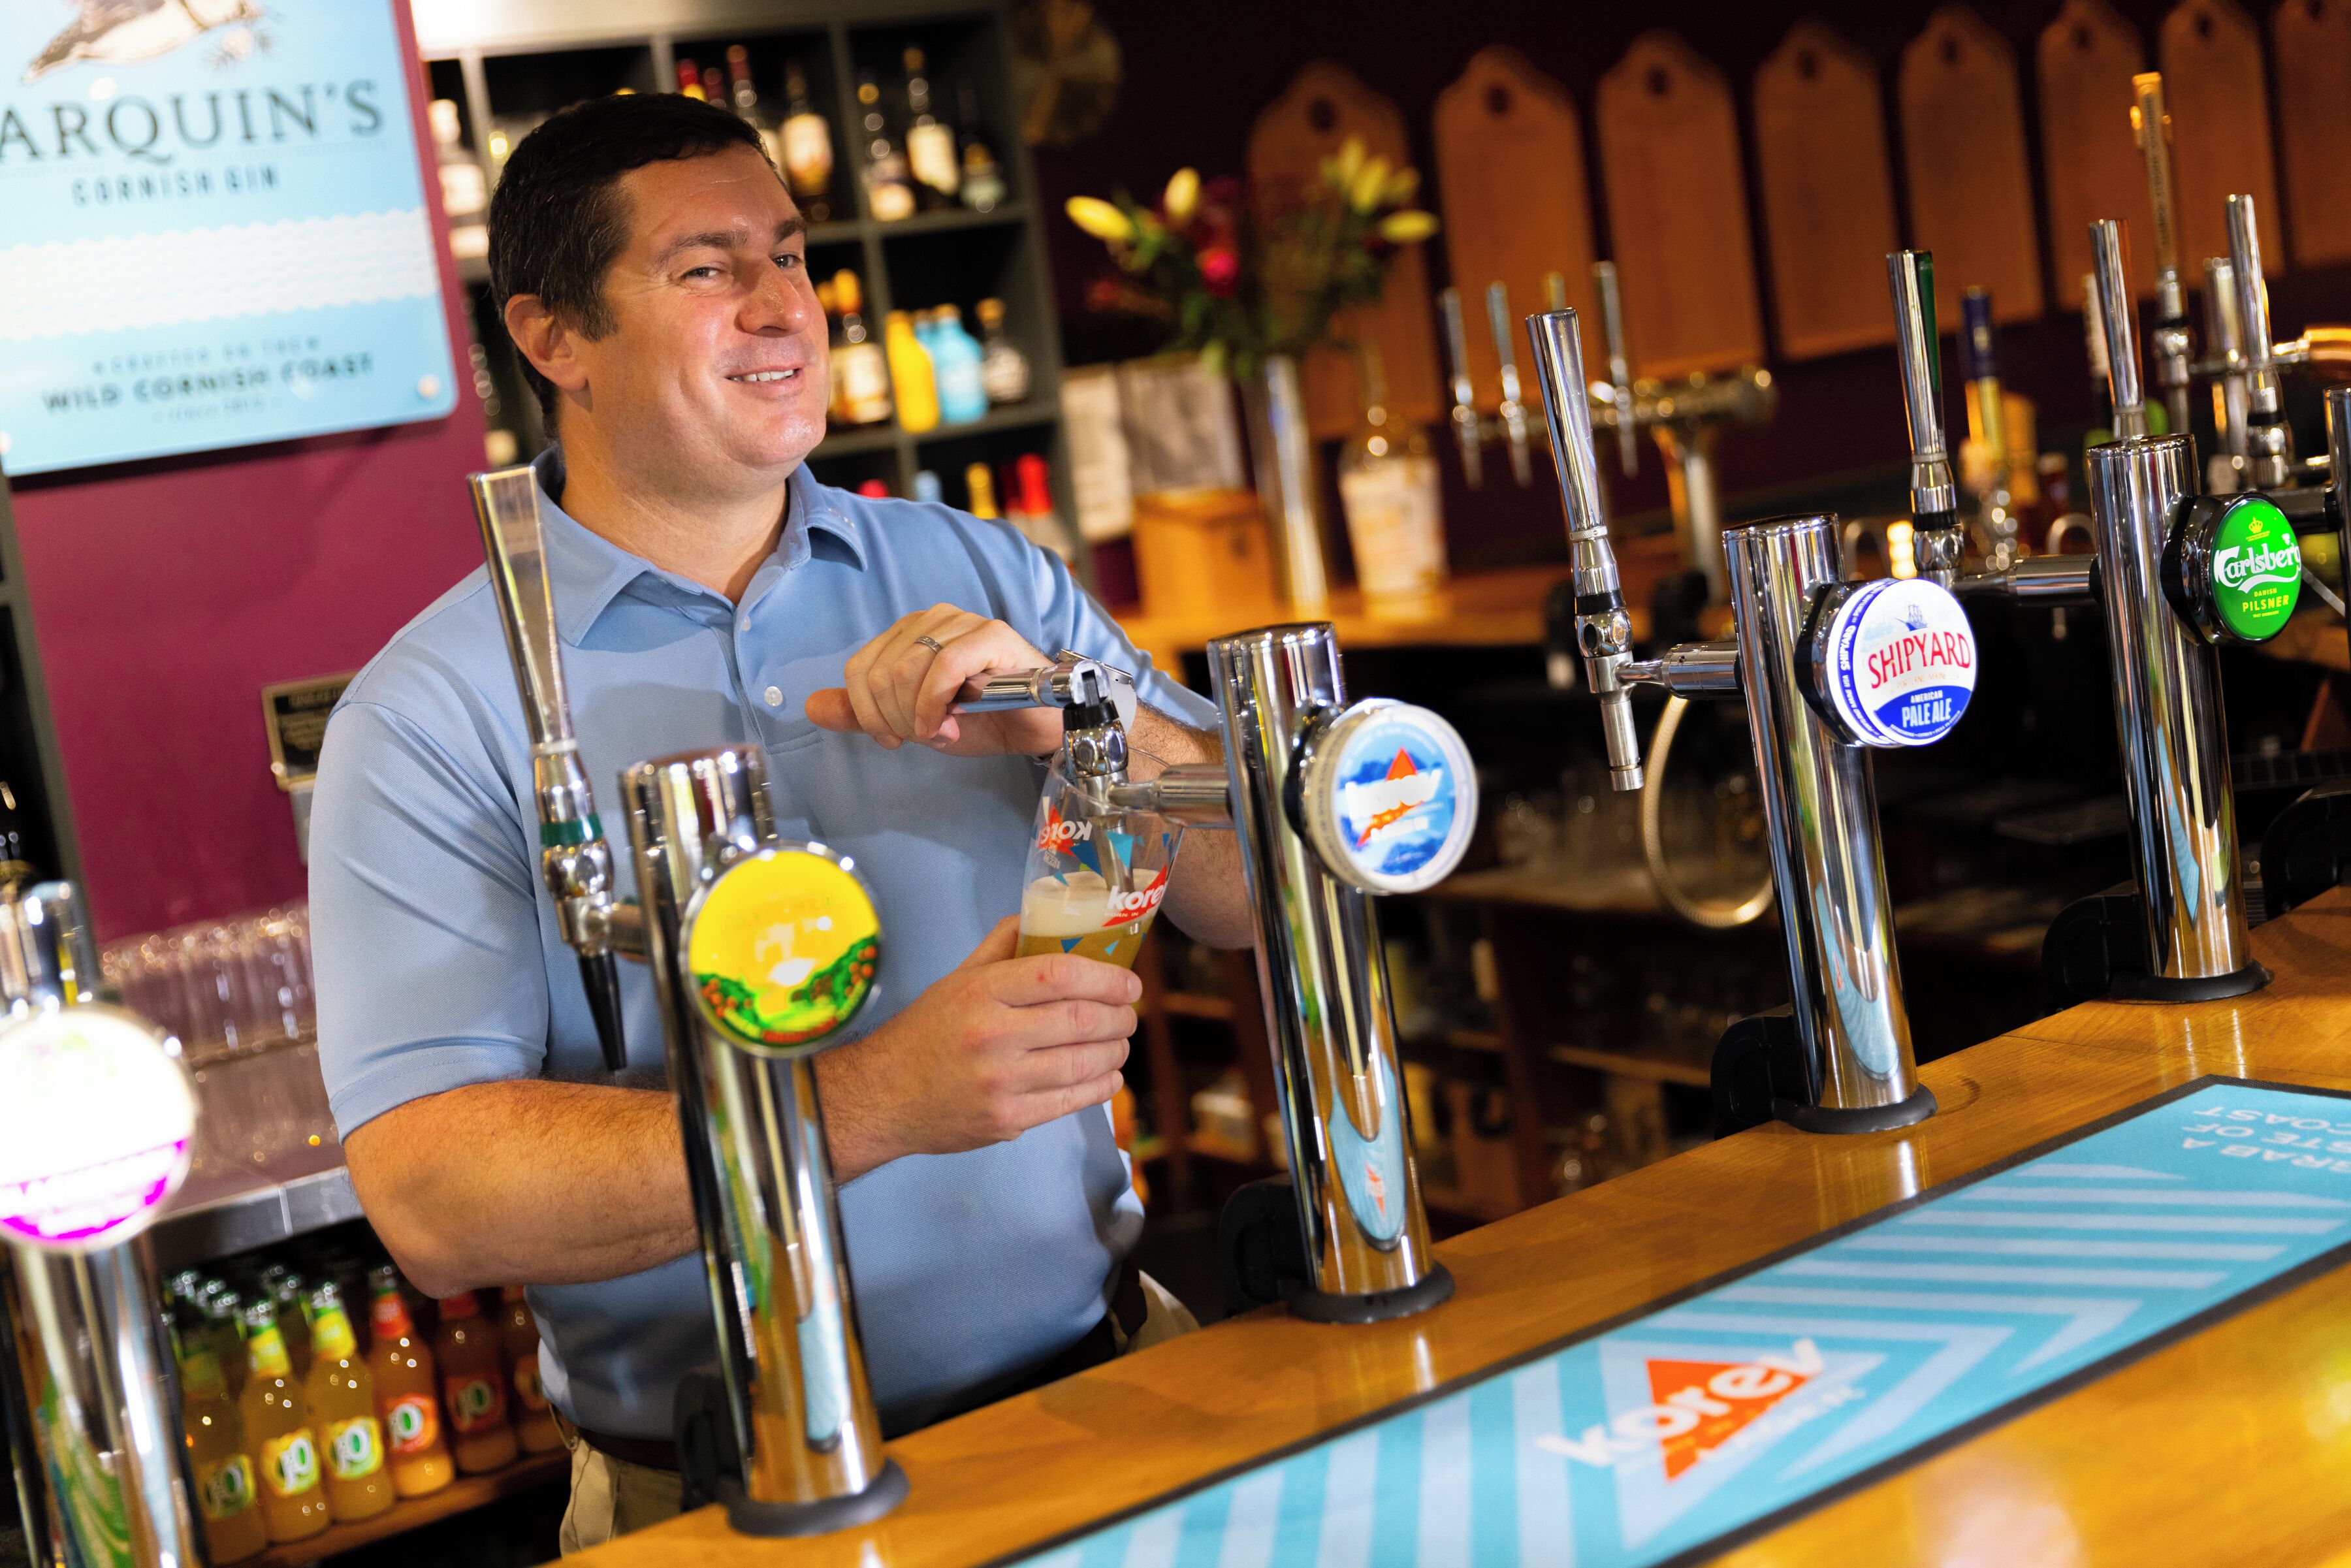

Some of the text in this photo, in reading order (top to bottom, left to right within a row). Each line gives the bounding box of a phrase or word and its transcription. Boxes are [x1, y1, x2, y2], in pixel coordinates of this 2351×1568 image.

[72, 162, 281, 206] CORNISH GIN
[40, 380, 120, 413] WILD
[133, 362, 273, 404] CORNISH
[2214, 543, 2301, 587] Carlsberg
[2242, 595, 2289, 612] PILSNER
[2254, 588, 2277, 597] DANISH
[1839, 625, 1856, 671] SHIPYARD
[1868, 631, 1971, 689] SHIPYARD
[1902, 697, 1952, 728] PALE ALE
[1910, 690, 1943, 703] AMERICAN
[2180, 1122, 2254, 1138] OF
[1533, 1338, 1823, 1467] korev
